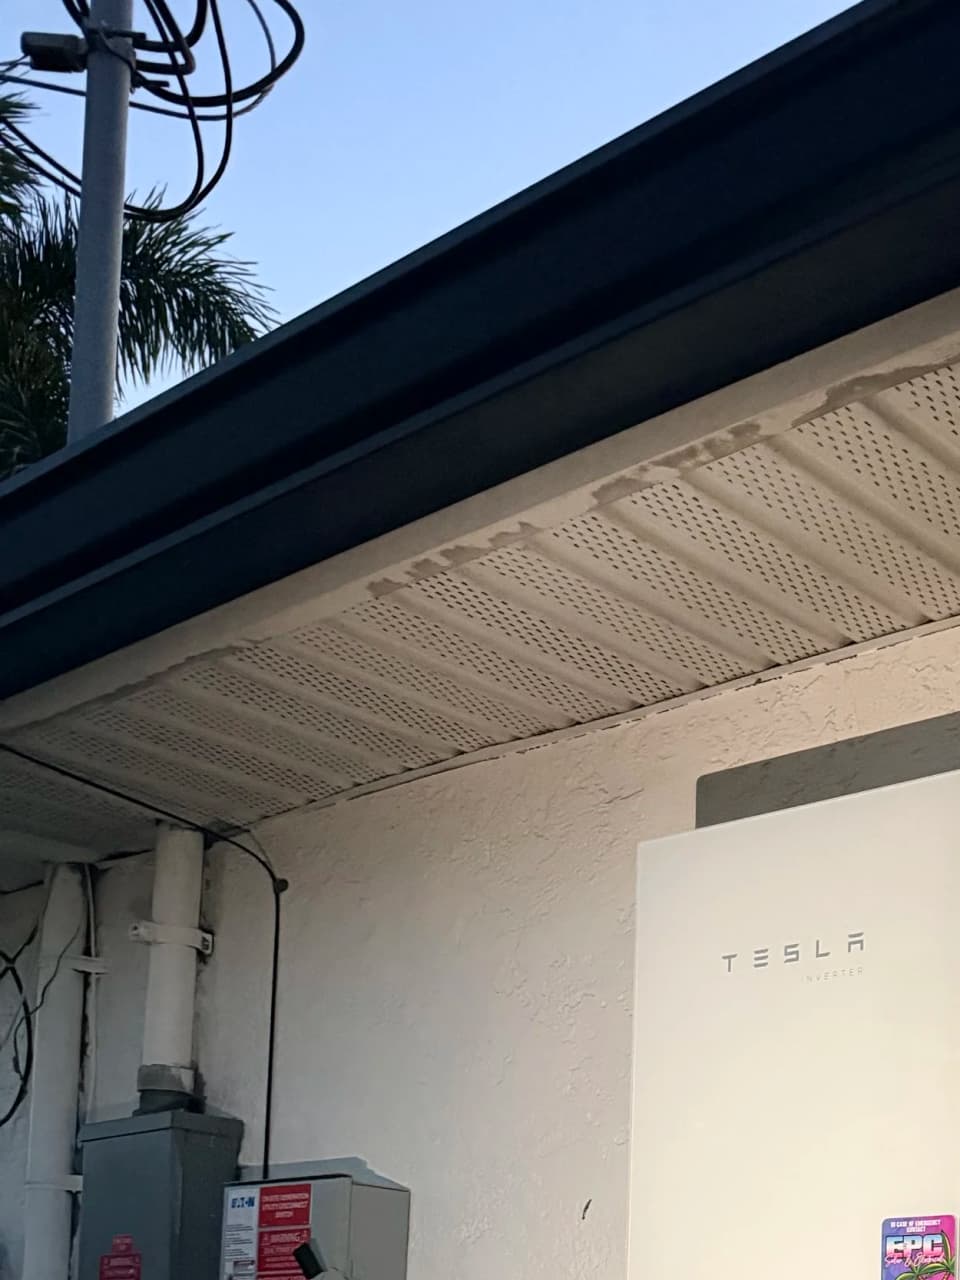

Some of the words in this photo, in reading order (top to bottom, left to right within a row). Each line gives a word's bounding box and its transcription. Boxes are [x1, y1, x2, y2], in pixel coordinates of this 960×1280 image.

[722, 932, 864, 972] TESLA
[232, 1196, 256, 1208] EATON
[886, 1234, 944, 1259] EPC
